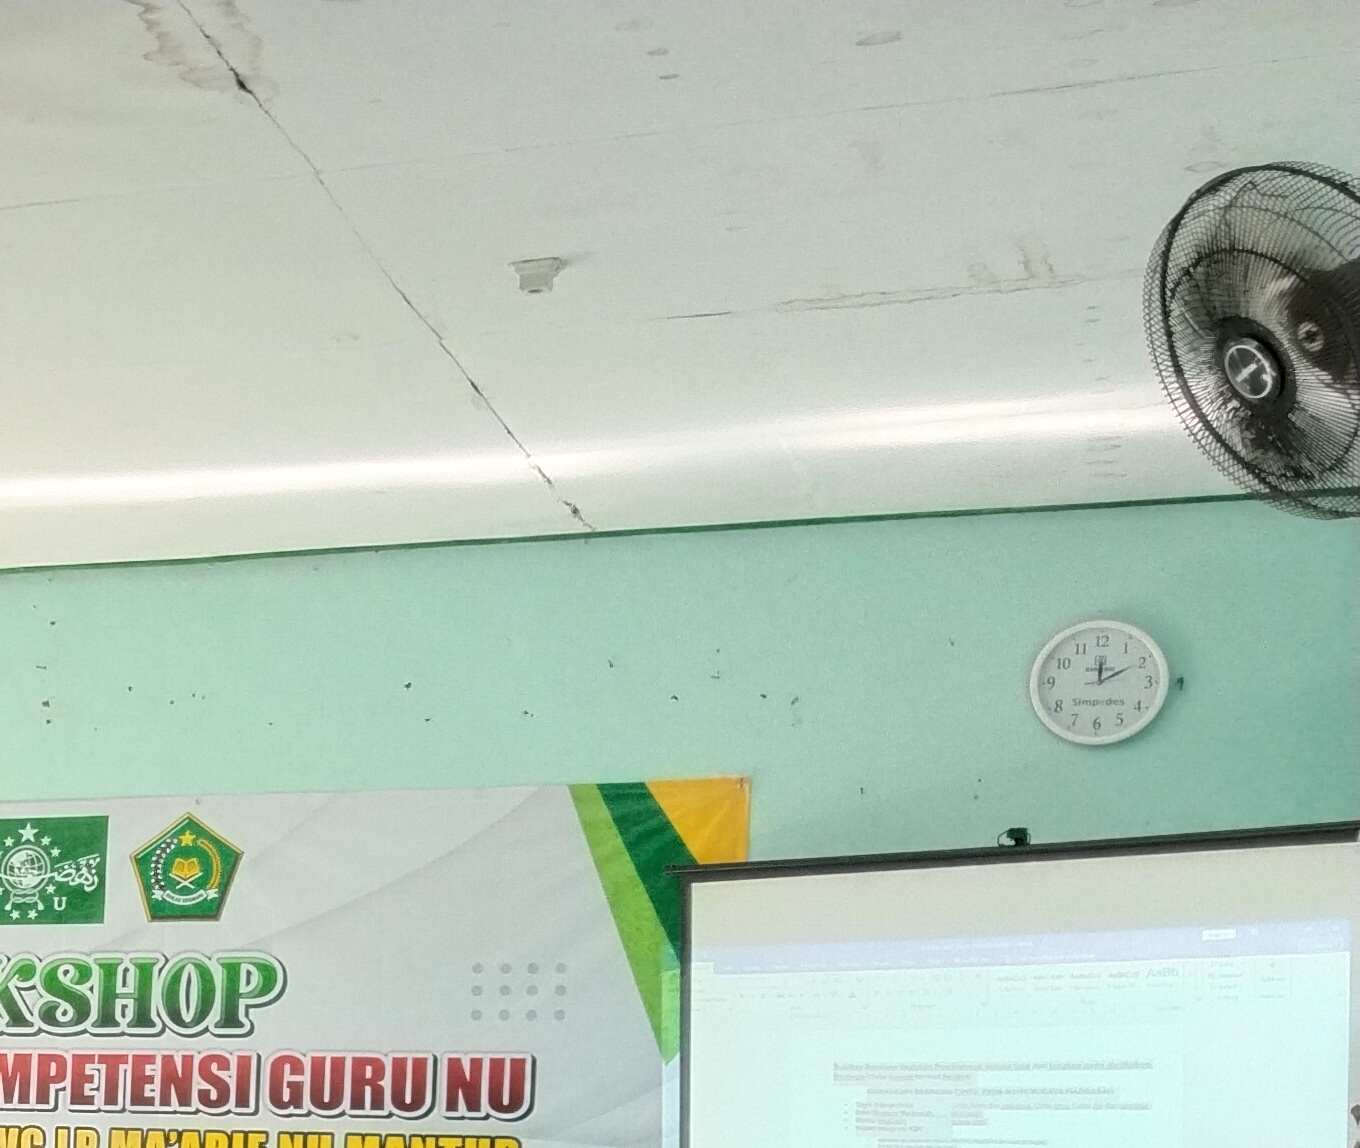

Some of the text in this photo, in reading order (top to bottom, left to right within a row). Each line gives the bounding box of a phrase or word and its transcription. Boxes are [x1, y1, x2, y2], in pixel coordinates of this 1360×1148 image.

[1074, 642, 1087, 655] 11
[1094, 635, 1110, 648] 12
[1123, 642, 1129, 655] 1
[1057, 657, 1071, 670] 10
[1137, 656, 1147, 669] 2
[1046, 675, 1056, 690] 9
[1143, 675, 1154, 690] 3
[1053, 699, 1064, 714] 8
[1132, 699, 1142, 712] 4
[1070, 713, 1079, 727] 7
[1092, 716, 1102, 731] 6
[1115, 712, 1124, 727] 5
[52, 896, 67, 911] U
[268, 1053, 429, 1113] GURU
[443, 1055, 528, 1115] NU
